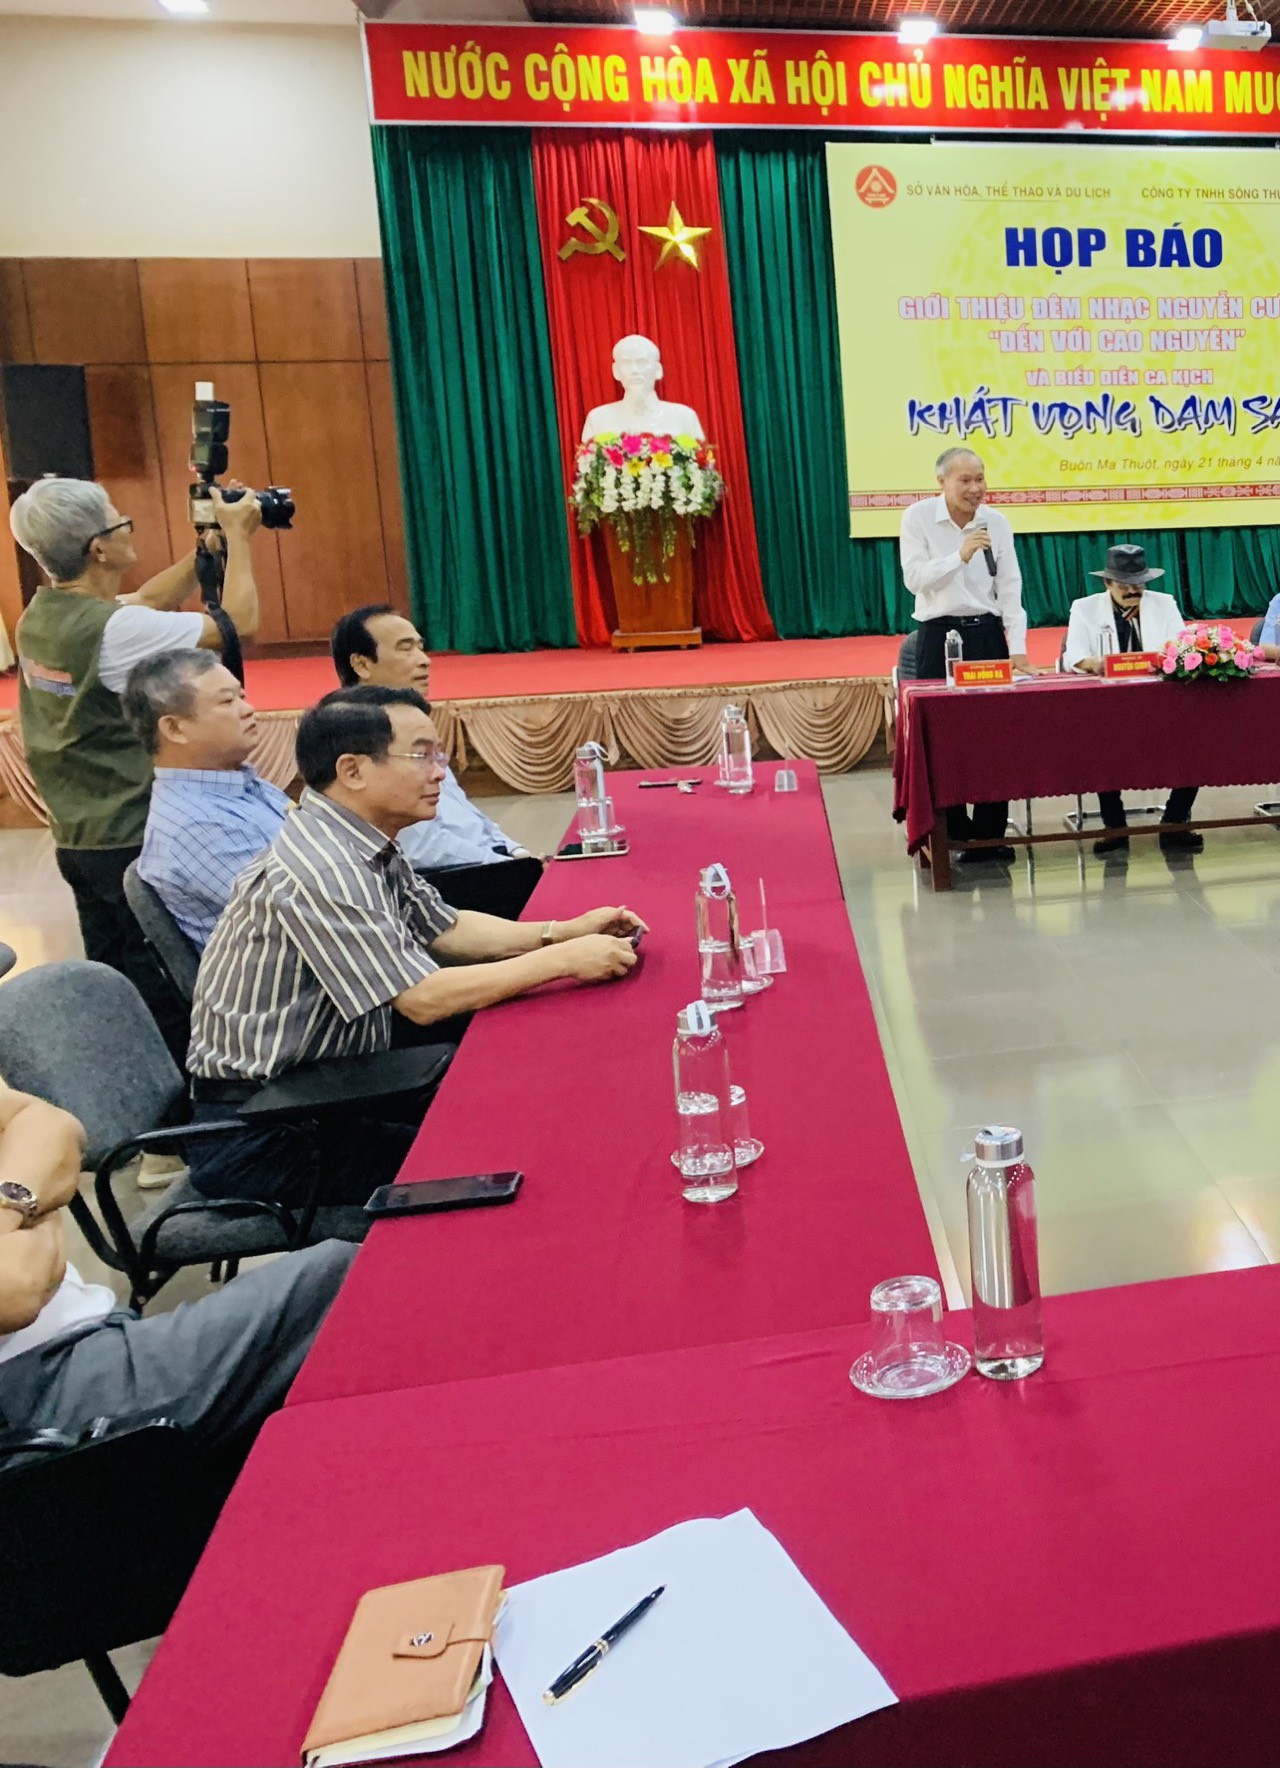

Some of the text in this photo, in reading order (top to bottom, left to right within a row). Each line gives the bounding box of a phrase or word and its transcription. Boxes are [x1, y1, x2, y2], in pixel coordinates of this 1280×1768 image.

[402, 40, 512, 99] NƯỚC
[524, 43, 628, 112] CỘNG
[640, 45, 719, 104] HÒA
[729, 49, 776, 105] XÃ
[787, 50, 848, 116] HỘI
[859, 49, 930, 108] CHỦ
[945, 56, 1049, 111] NGHĨA
[1057, 58, 1130, 121] VIỆT
[1142, 70, 1213, 114] NAM
[906, 180, 924, 196] SỞ
[1012, 185, 1045, 198] THAO
[1046, 183, 1062, 197] VÀ
[1065, 186, 1082, 198] DU
[1085, 186, 1111, 200] LỊCH
[1141, 184, 1175, 199] CÔNG
[1177, 188, 1192, 199] TY
[1195, 188, 1226, 199] TNHH
[1228, 185, 1260, 200] SÔNG
[1004, 222, 1223, 274] HỌP BÁO
[898, 293, 950, 320] GIỚI
[955, 293, 1025, 324] THIỆU
[1031, 293, 1082, 320] ĐÊM
[1088, 296, 1151, 324] NHẠC
[1157, 290, 1244, 320] NGUYỄN
[1050, 326, 1092, 352] VỚI
[1098, 329, 1143, 352] CAO
[1025, 367, 1051, 387] VÀ
[1100, 365, 1140, 386] DIỄN
[1144, 369, 1169, 386] CA
[1172, 368, 1214, 388] KỊCH
[906, 385, 1027, 440] KHÁT
[1031, 392, 1143, 440] VỌNG
[1059, 459, 1093, 471] Buôn
[1097, 459, 1117, 470] Ma
[1163, 456, 1194, 471] ngày
[1197, 456, 1213, 468] 21
[1217, 455, 1252, 469] tháng
[1255, 455, 1263, 465] 4
